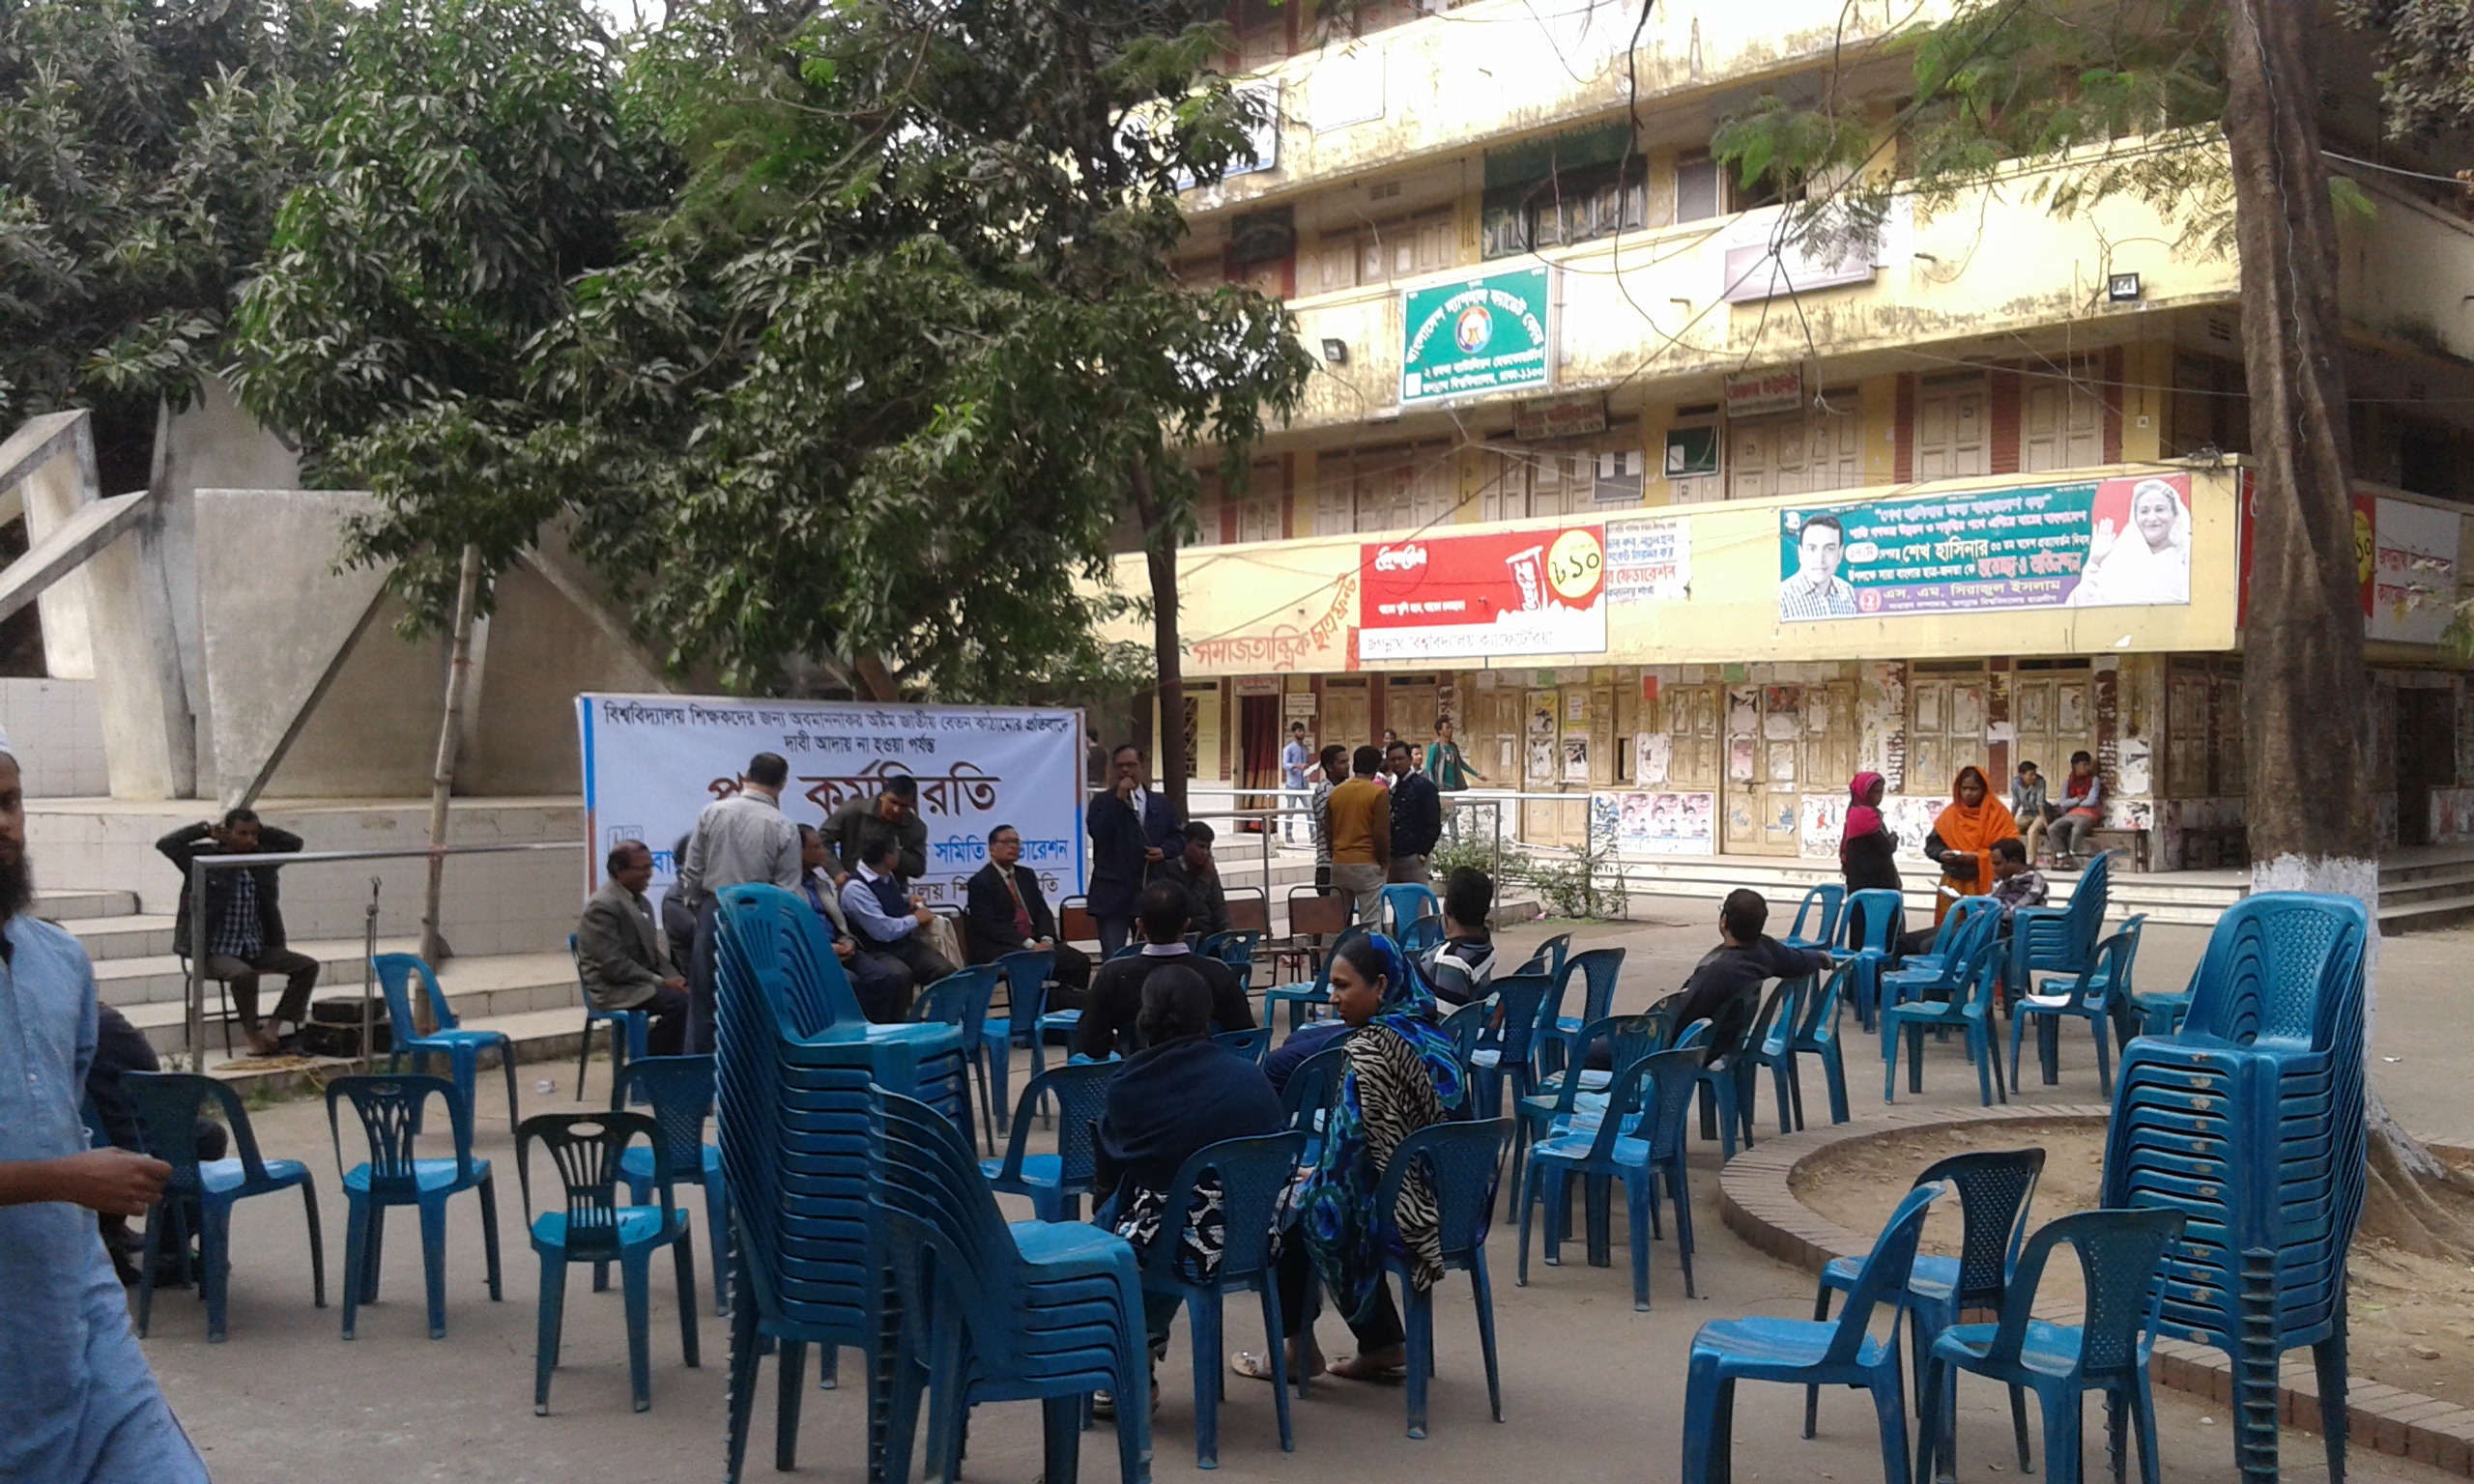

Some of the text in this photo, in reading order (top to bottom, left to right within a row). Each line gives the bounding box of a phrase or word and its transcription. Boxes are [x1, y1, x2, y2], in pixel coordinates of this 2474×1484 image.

[1903, 542, 1930, 562] শেখ
[1933, 535, 1988, 562] হাসিনার
[1617, 563, 1676, 585] ফেডারেশন
[1950, 583, 2005, 597] সিরাজুল
[2010, 580, 2060, 594] ইসলাম
[1194, 624, 1310, 671] সমাজতান্ত্রিক
[1310, 611, 1338, 652] ছাত্র
[604, 700, 685, 726] বিশ্ববিদ্যালয়
[690, 702, 754, 727] শিক্ষকদের
[759, 709, 786, 727] জন্য
[789, 711, 862, 728] অবমাননাকর
[898, 708, 936, 730] জাতীয়
[940, 715, 971, 731] বেতন
[974, 710, 1021, 732] কাঠামোর
[1024, 712, 1068, 733] প্রতিবাদে
[784, 729, 935, 755] দাবী আদায় না হওয়া পর্যন্ত
[935, 835, 987, 863] সমিতি
